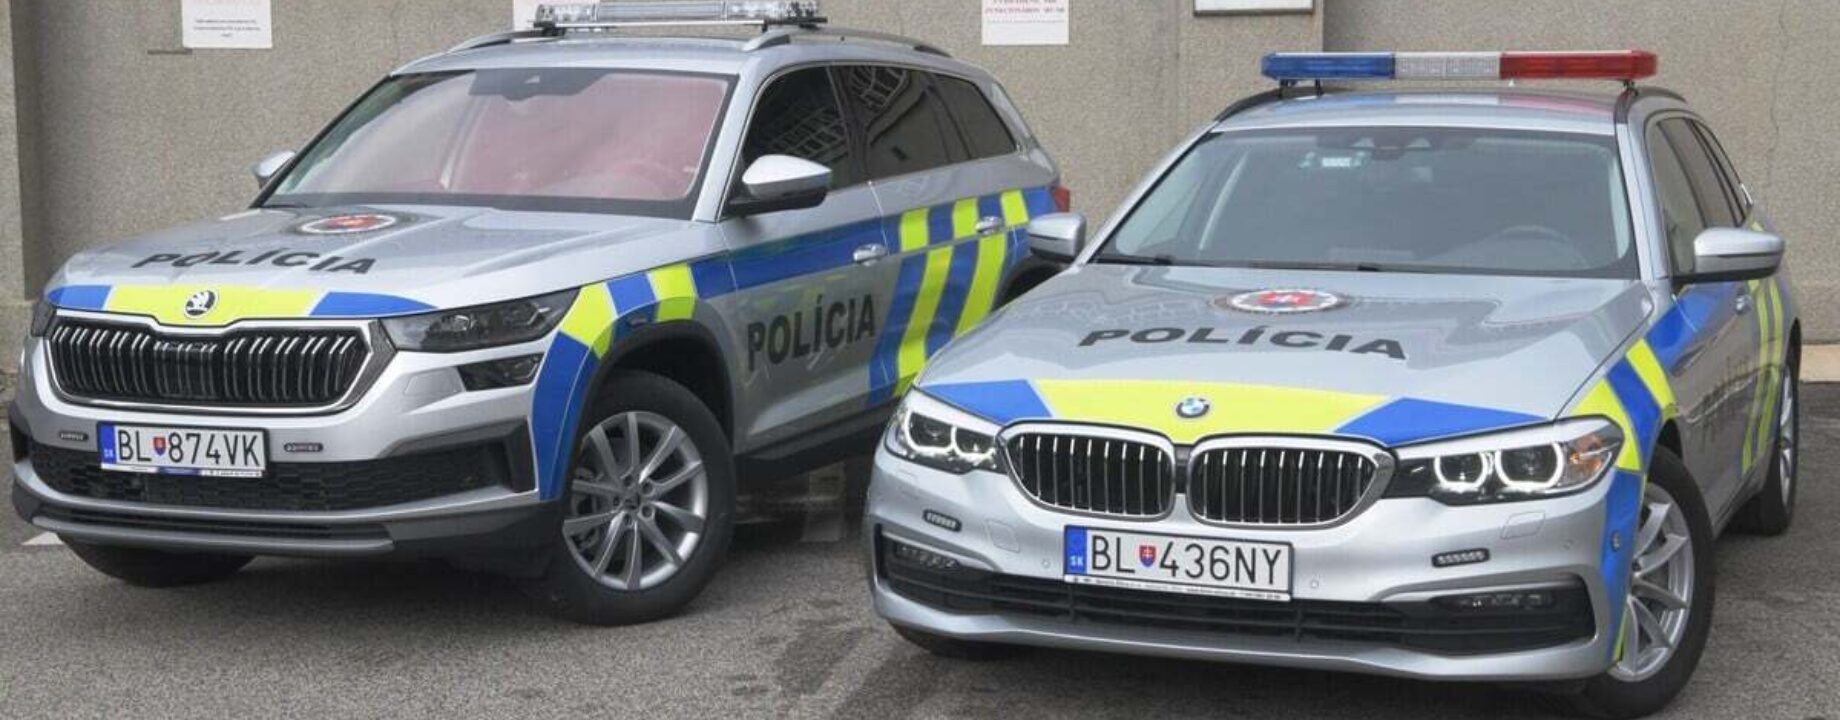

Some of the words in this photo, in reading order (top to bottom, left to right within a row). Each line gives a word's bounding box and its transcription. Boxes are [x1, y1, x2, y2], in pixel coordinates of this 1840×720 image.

[747, 293, 876, 372] POLÍCIA
[1078, 325, 1407, 360] POLÍCIA
[119, 430, 152, 462] BL
[168, 432, 260, 466] 874VK
[1092, 535, 1135, 573] BL
[1159, 541, 1281, 584] 436NY
